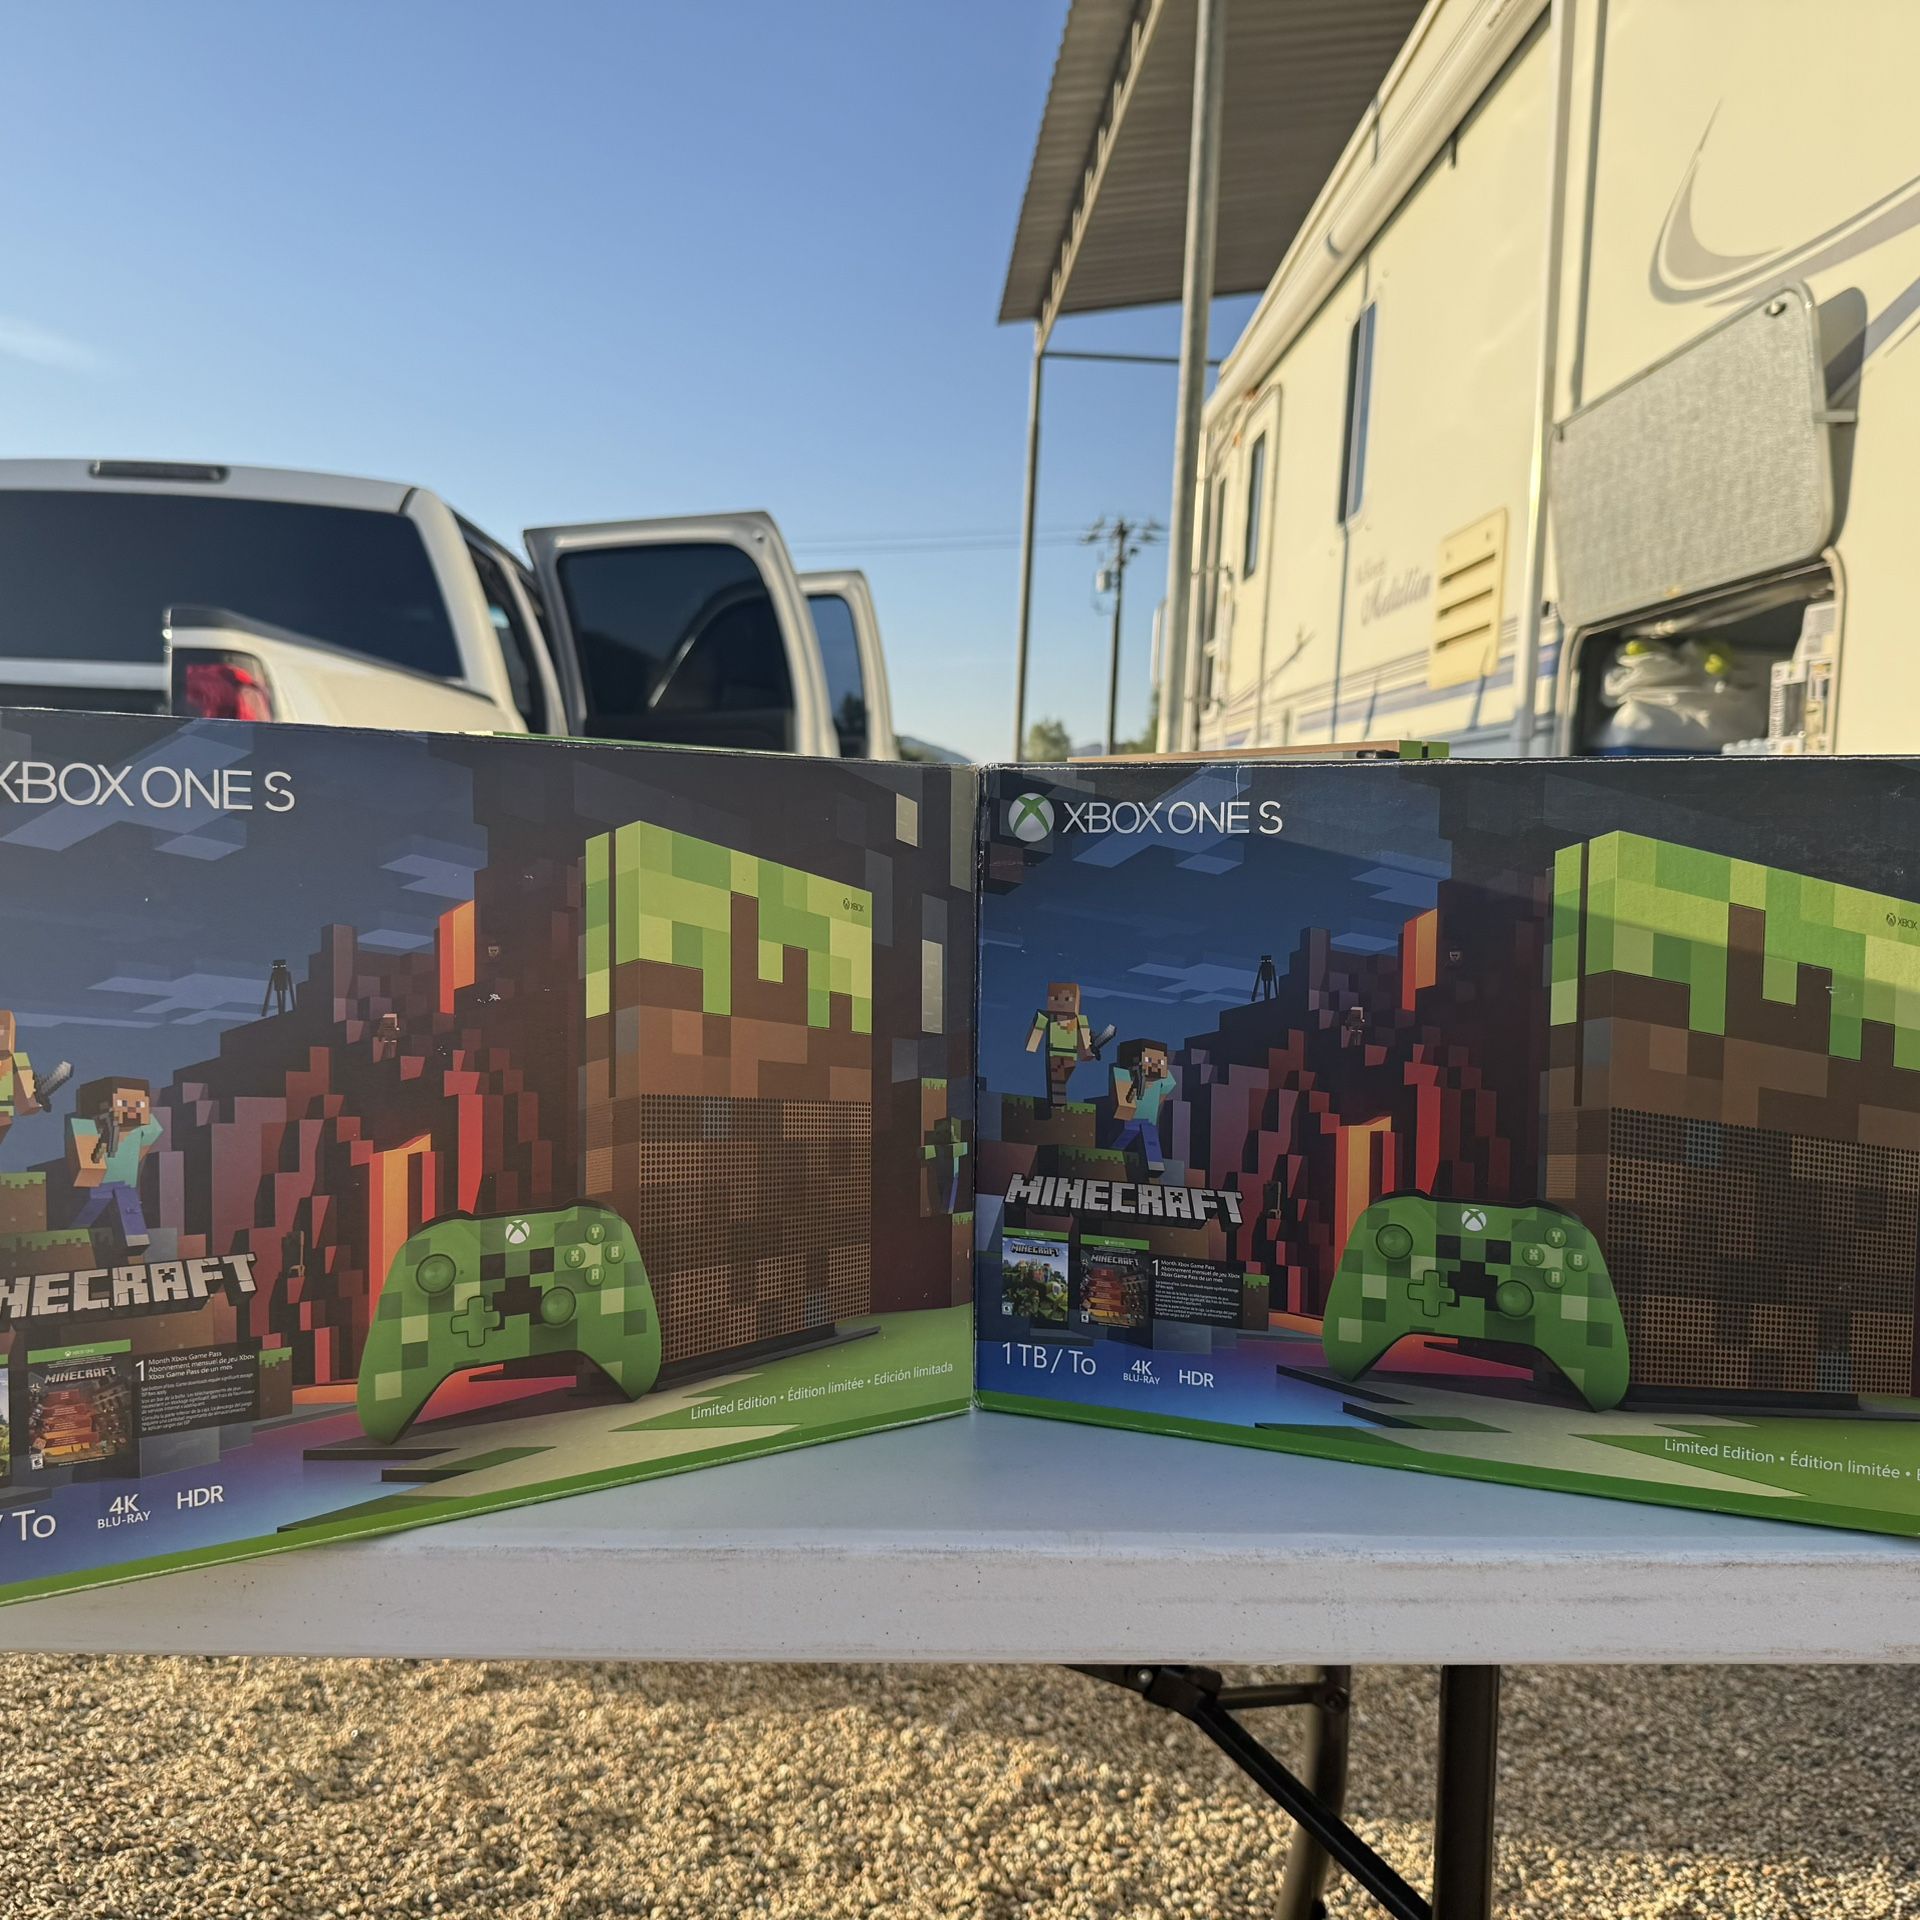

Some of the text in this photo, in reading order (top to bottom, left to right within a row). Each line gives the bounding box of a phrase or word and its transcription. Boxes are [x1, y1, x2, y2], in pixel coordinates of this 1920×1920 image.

[141, 766, 254, 811] ONE
[264, 771, 296, 812] S
[1062, 800, 1283, 835] XBOX ONE S
[1004, 1173, 1243, 1225] MINECRAFT
[591, 1227, 600, 1239] Y
[1551, 1231, 1561, 1243] Y
[1090, 1254, 1139, 1266] MINECRAFT
[1152, 1259, 1159, 1276] 1
[148, 1357, 171, 1366] Month
[188, 1353, 208, 1361] Game
[148, 1362, 191, 1373] Abonnement
[1131, 1359, 1152, 1375] 4K
[44, 1366, 116, 1384] MINECRAFT
[135, 1360, 145, 1382] 1
[166, 1370, 185, 1378] Game
[1123, 1372, 1161, 1385] BLU-RAY
[1179, 1369, 1214, 1388] HDR
[691, 1361, 953, 1420] Limited Edition Édition limitée Edición limitada
[1664, 1438, 1718, 1457] Limited
[1723, 1445, 1774, 1464] Edition
[1790, 1451, 1843, 1472] Édition
[1847, 1459, 1900, 1479] limitée
[109, 1493, 140, 1515] 4K
[176, 1485, 225, 1510] HDR
[12, 1509, 57, 1541] To
[97, 1510, 151, 1529] BLU-RAY
